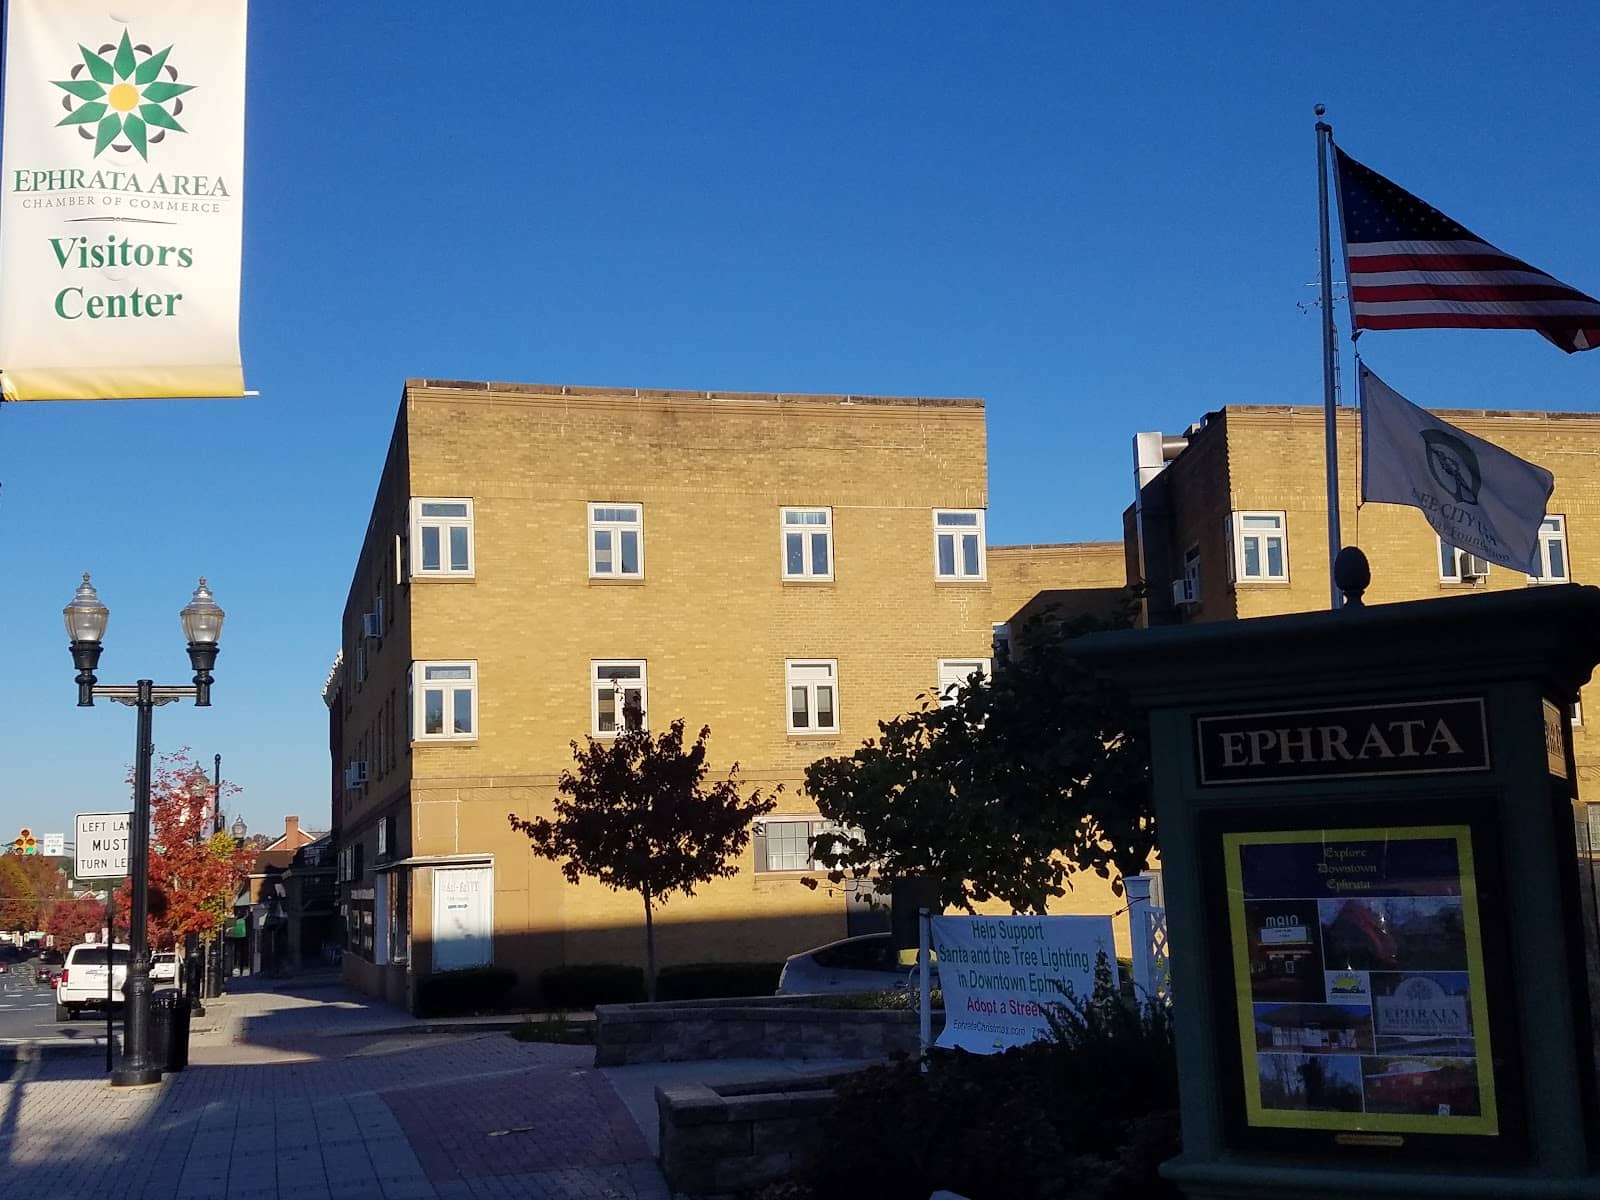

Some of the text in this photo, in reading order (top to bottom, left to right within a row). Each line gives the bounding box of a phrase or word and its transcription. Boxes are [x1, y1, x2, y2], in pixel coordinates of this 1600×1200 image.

[13, 169, 231, 198] EPHRATA AREA
[22, 196, 221, 214] CHAMBER OF COMMERCE
[48, 234, 194, 270] Visitors
[54, 286, 183, 320] Center
[1441, 503, 1475, 526] CITY
[1219, 718, 1464, 768] EPHRATA
[82, 821, 132, 832] LEFT LAN
[92, 838, 128, 851] MUST
[1324, 847, 1367, 861] Explore
[80, 859, 108, 870] TURN
[1317, 863, 1377, 873] Downtown
[1326, 878, 1371, 893] Ephrata
[971, 920, 1044, 943] Help Support
[939, 944, 1090, 973] Santa and the Tree Lighting
[957, 969, 967, 987] in
[969, 970, 1026, 991] Downtown
[967, 997, 997, 1016] Adopt
[999, 1004, 1006, 1014] a
[1009, 1000, 1042, 1017] Street
